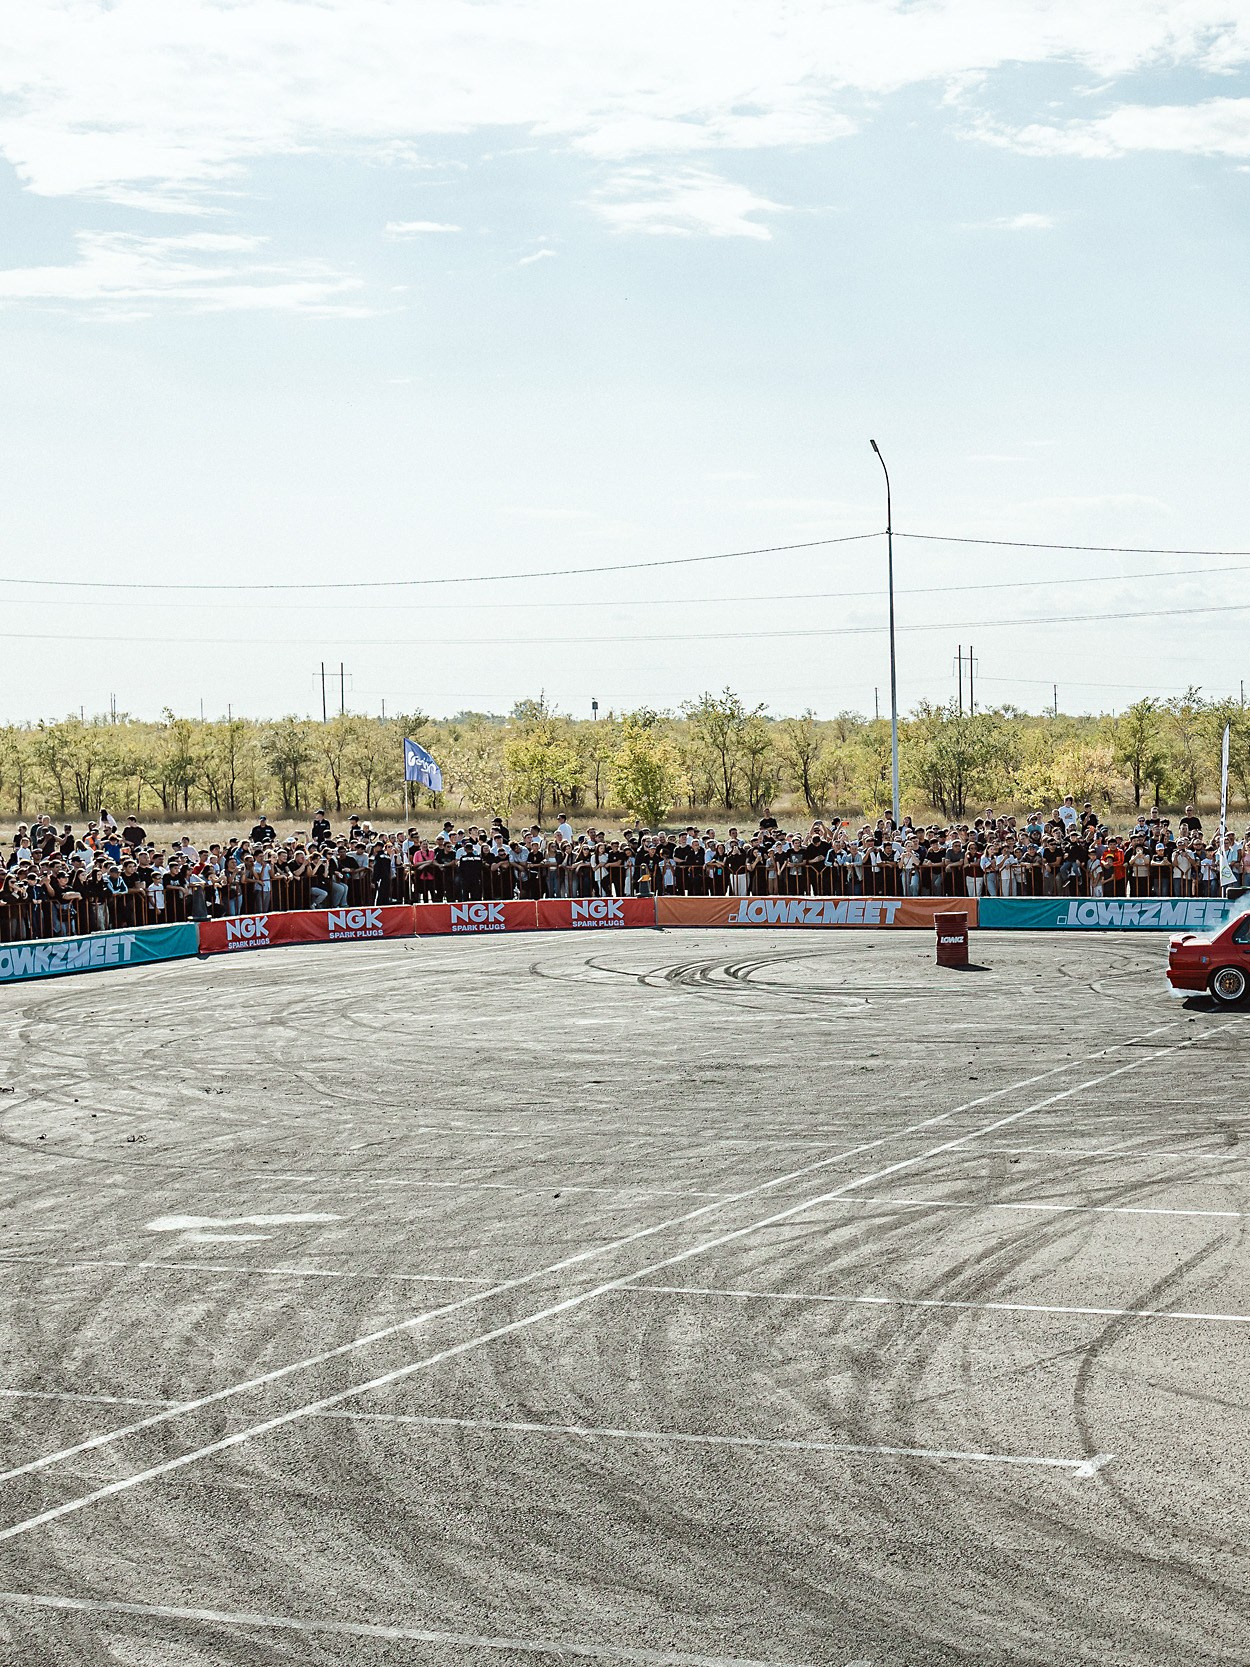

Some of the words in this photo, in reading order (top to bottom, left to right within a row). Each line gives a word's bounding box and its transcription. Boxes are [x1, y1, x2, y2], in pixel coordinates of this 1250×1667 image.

[450, 902, 506, 923] NGK
[570, 899, 625, 919] NGK
[738, 900, 902, 924] LOWKZMEET
[225, 915, 269, 941] NGK
[328, 908, 383, 931] NGK
[479, 923, 506, 931] PLUGS
[599, 919, 625, 927] PLUGS
[357, 929, 384, 937] PLUGS
[228, 941, 249, 949] SPARK
[249, 938, 270, 947] PLUGS
